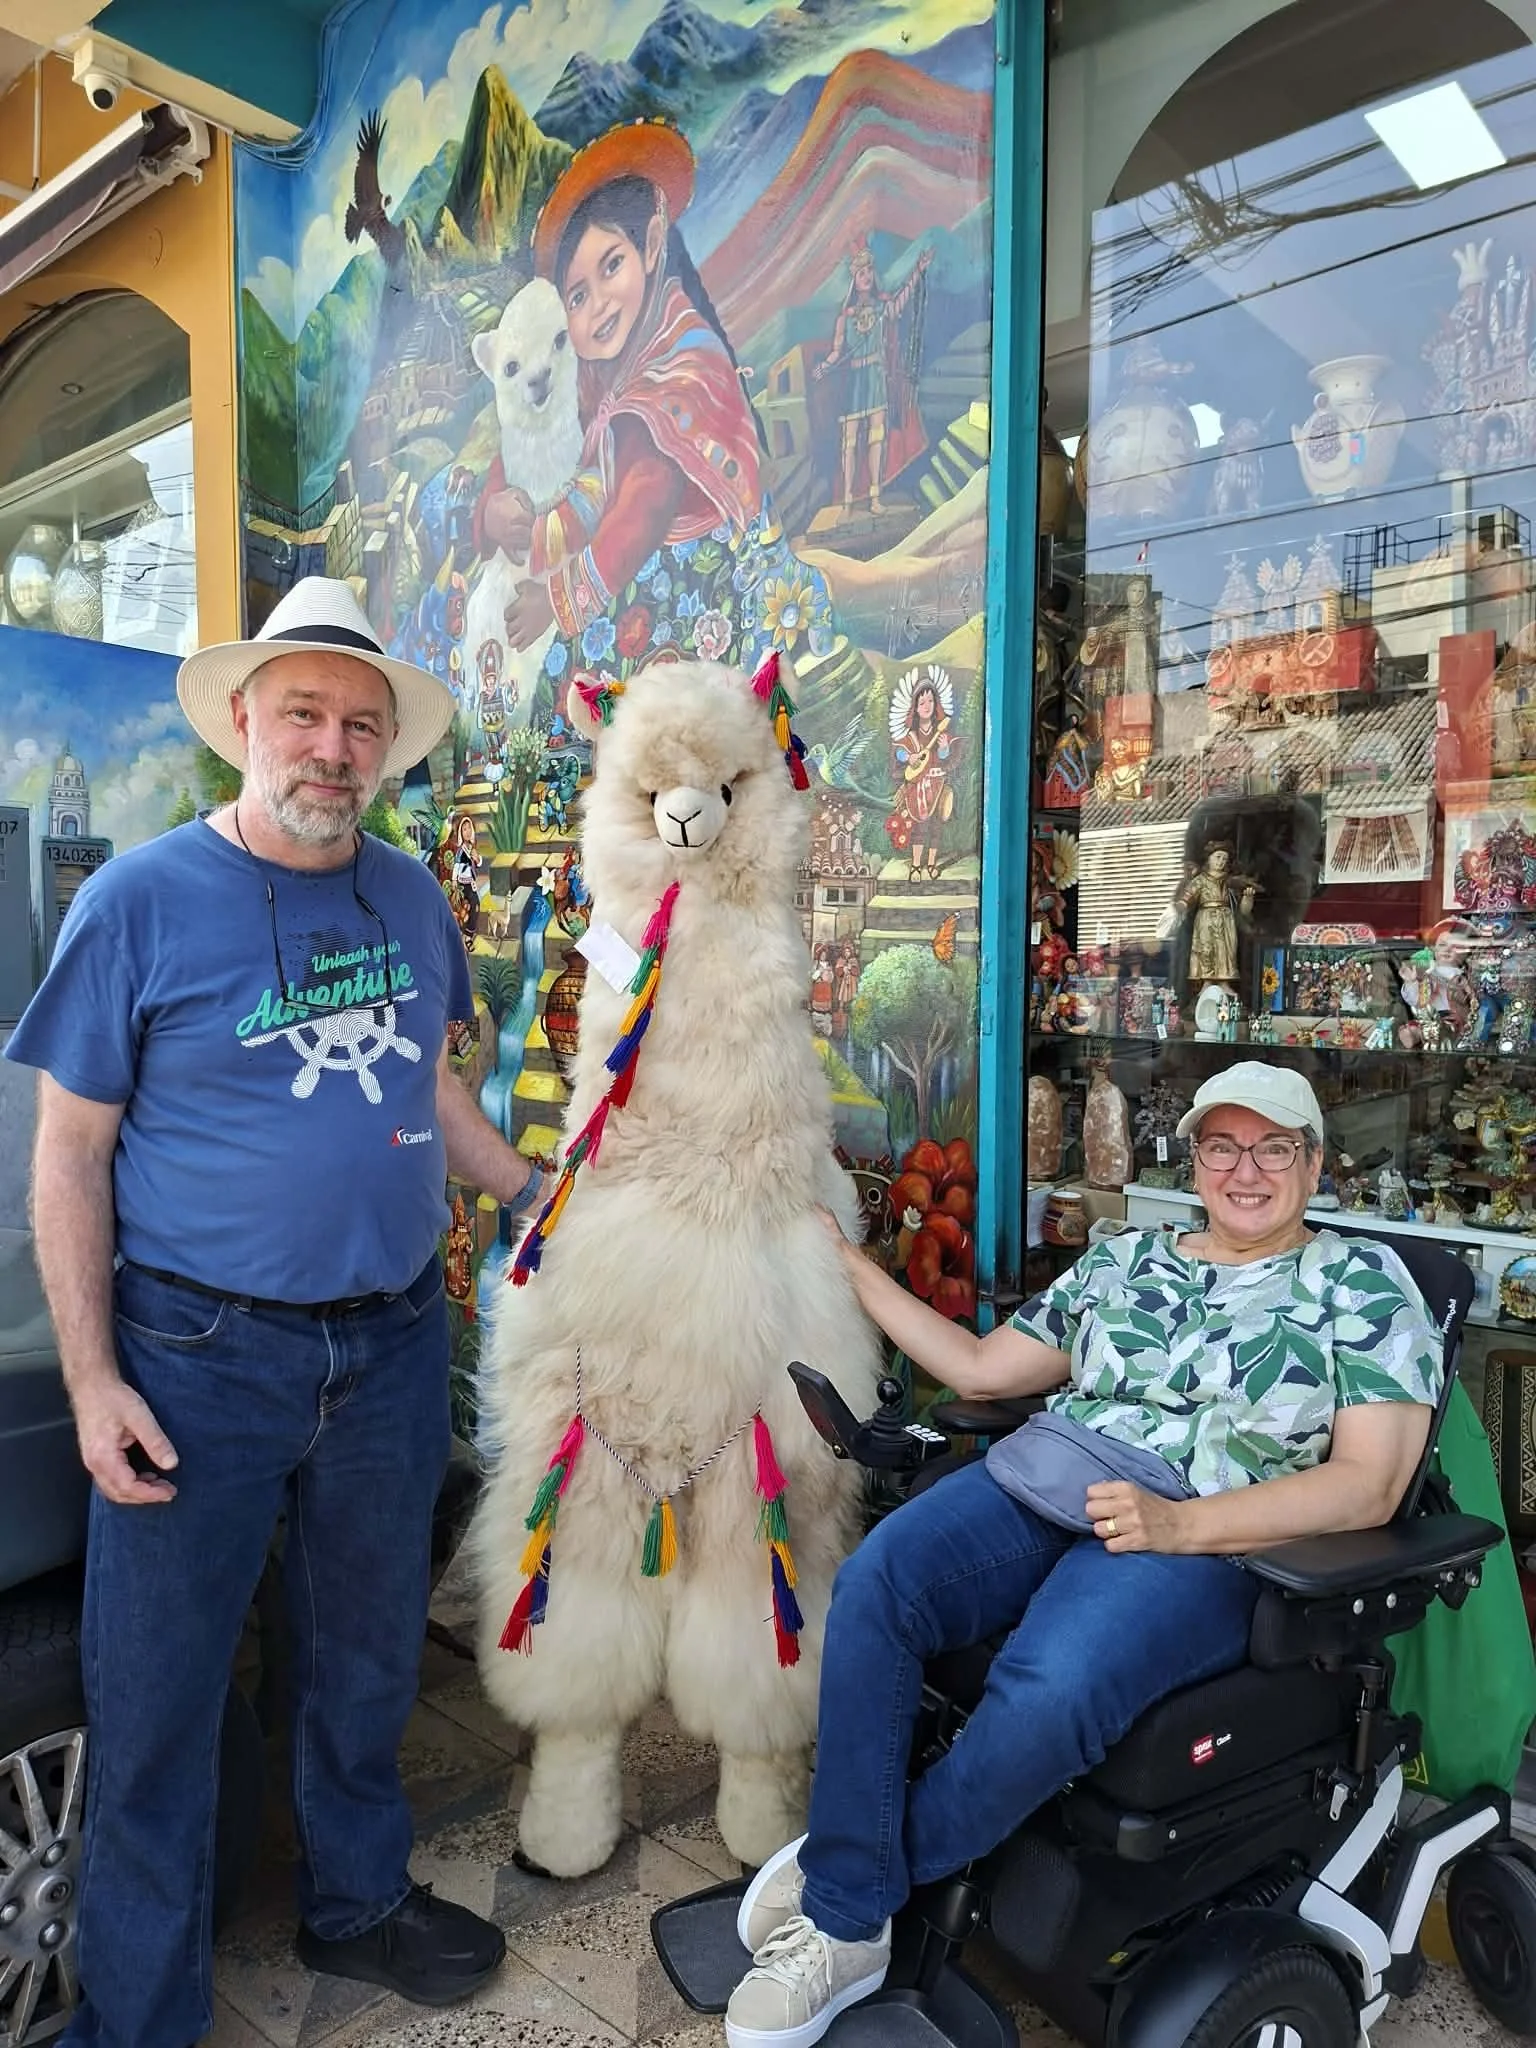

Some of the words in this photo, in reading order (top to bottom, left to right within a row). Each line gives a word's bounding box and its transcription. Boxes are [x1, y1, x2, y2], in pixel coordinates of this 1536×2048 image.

[46, 846, 105, 864] 1340265
[311, 944, 369, 974] Unleash
[235, 962, 414, 1037] Adventure
